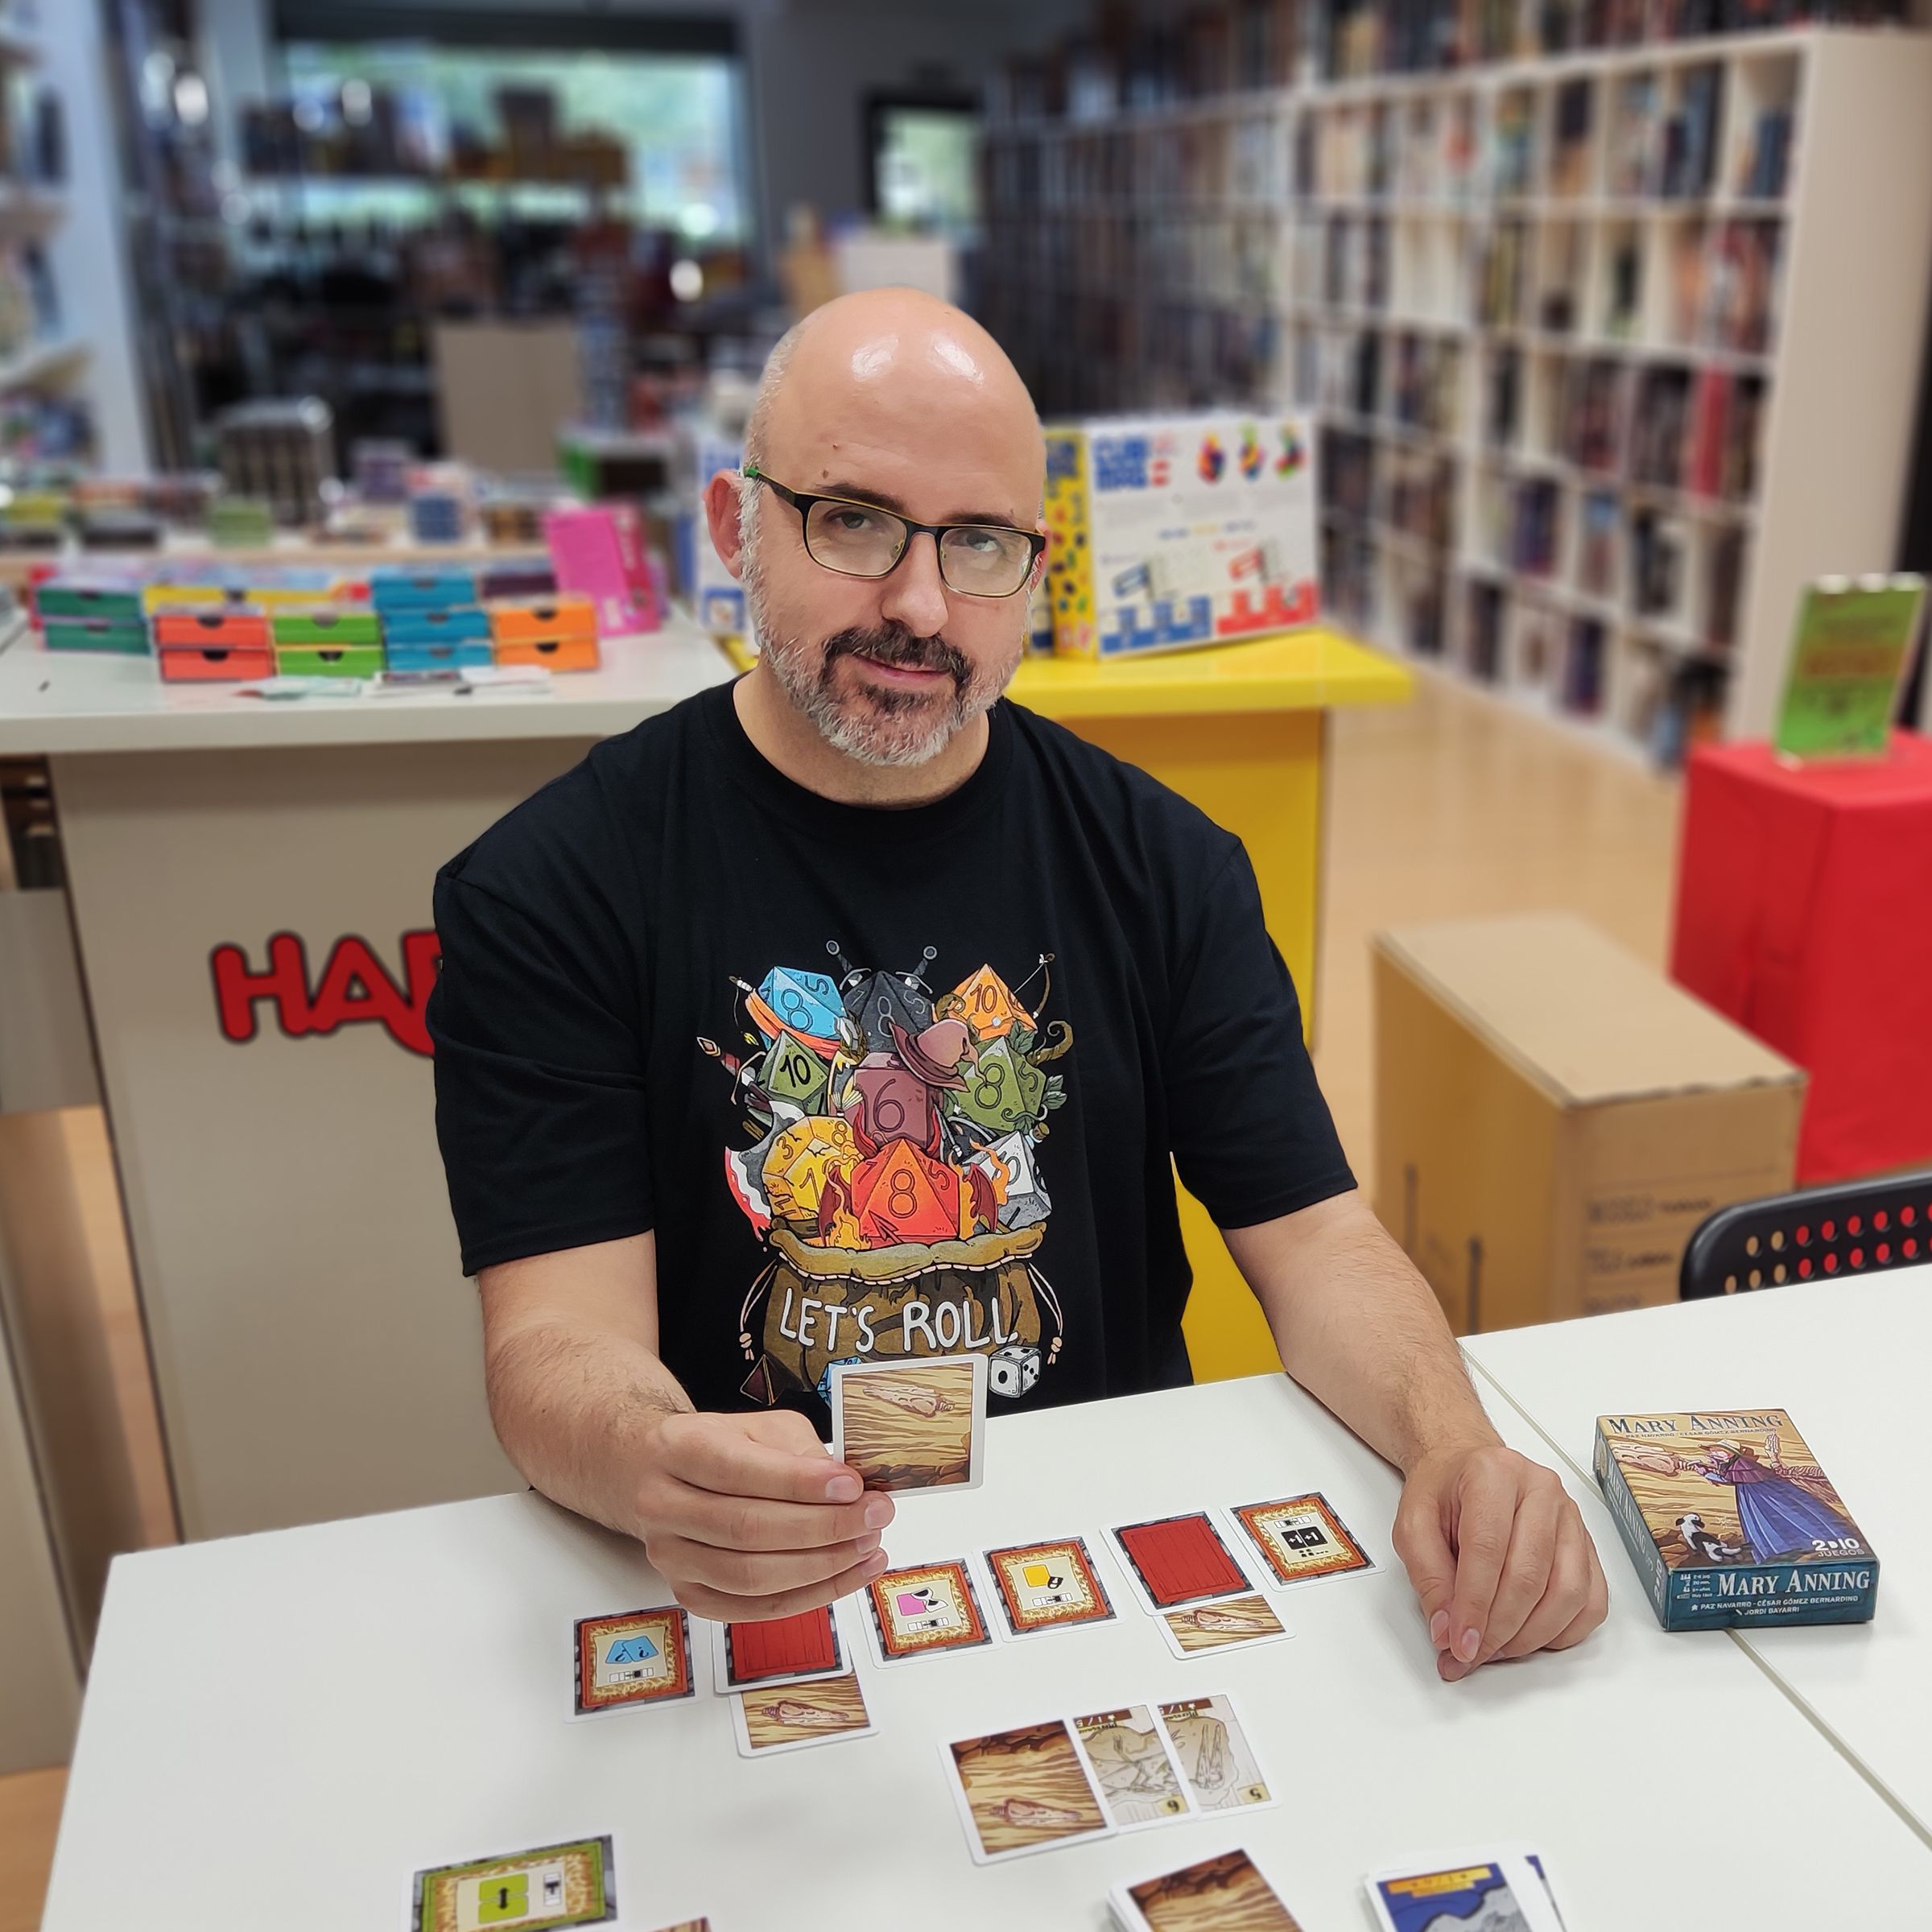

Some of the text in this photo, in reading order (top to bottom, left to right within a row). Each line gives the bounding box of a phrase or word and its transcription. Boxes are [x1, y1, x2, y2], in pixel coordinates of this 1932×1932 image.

[781, 989, 813, 1031] 8
[969, 983, 997, 1013] 10
[877, 996, 896, 1038] 8
[779, 1055, 811, 1088] 10
[975, 1063, 1005, 1109] 8
[1018, 1061, 1038, 1092] 5
[873, 1079, 905, 1133] 6
[776, 1136, 794, 1160] 3
[928, 1161, 950, 1191] 5
[888, 1168, 918, 1219] 8
[779, 1287, 1018, 1353] LET'S ROLL
[1607, 1414, 1783, 1435] MARY ANNING
[1818, 1548, 1865, 1557] JUEGOS
[1716, 1570, 1870, 1597] MARY ANNING
[1716, 1600, 1752, 1609] NAVARRO
[1810, 1595, 1859, 1604] BERNARDINO
[1744, 1608, 1767, 1616] JORDI
[1249, 1787, 1262, 1800] 5
